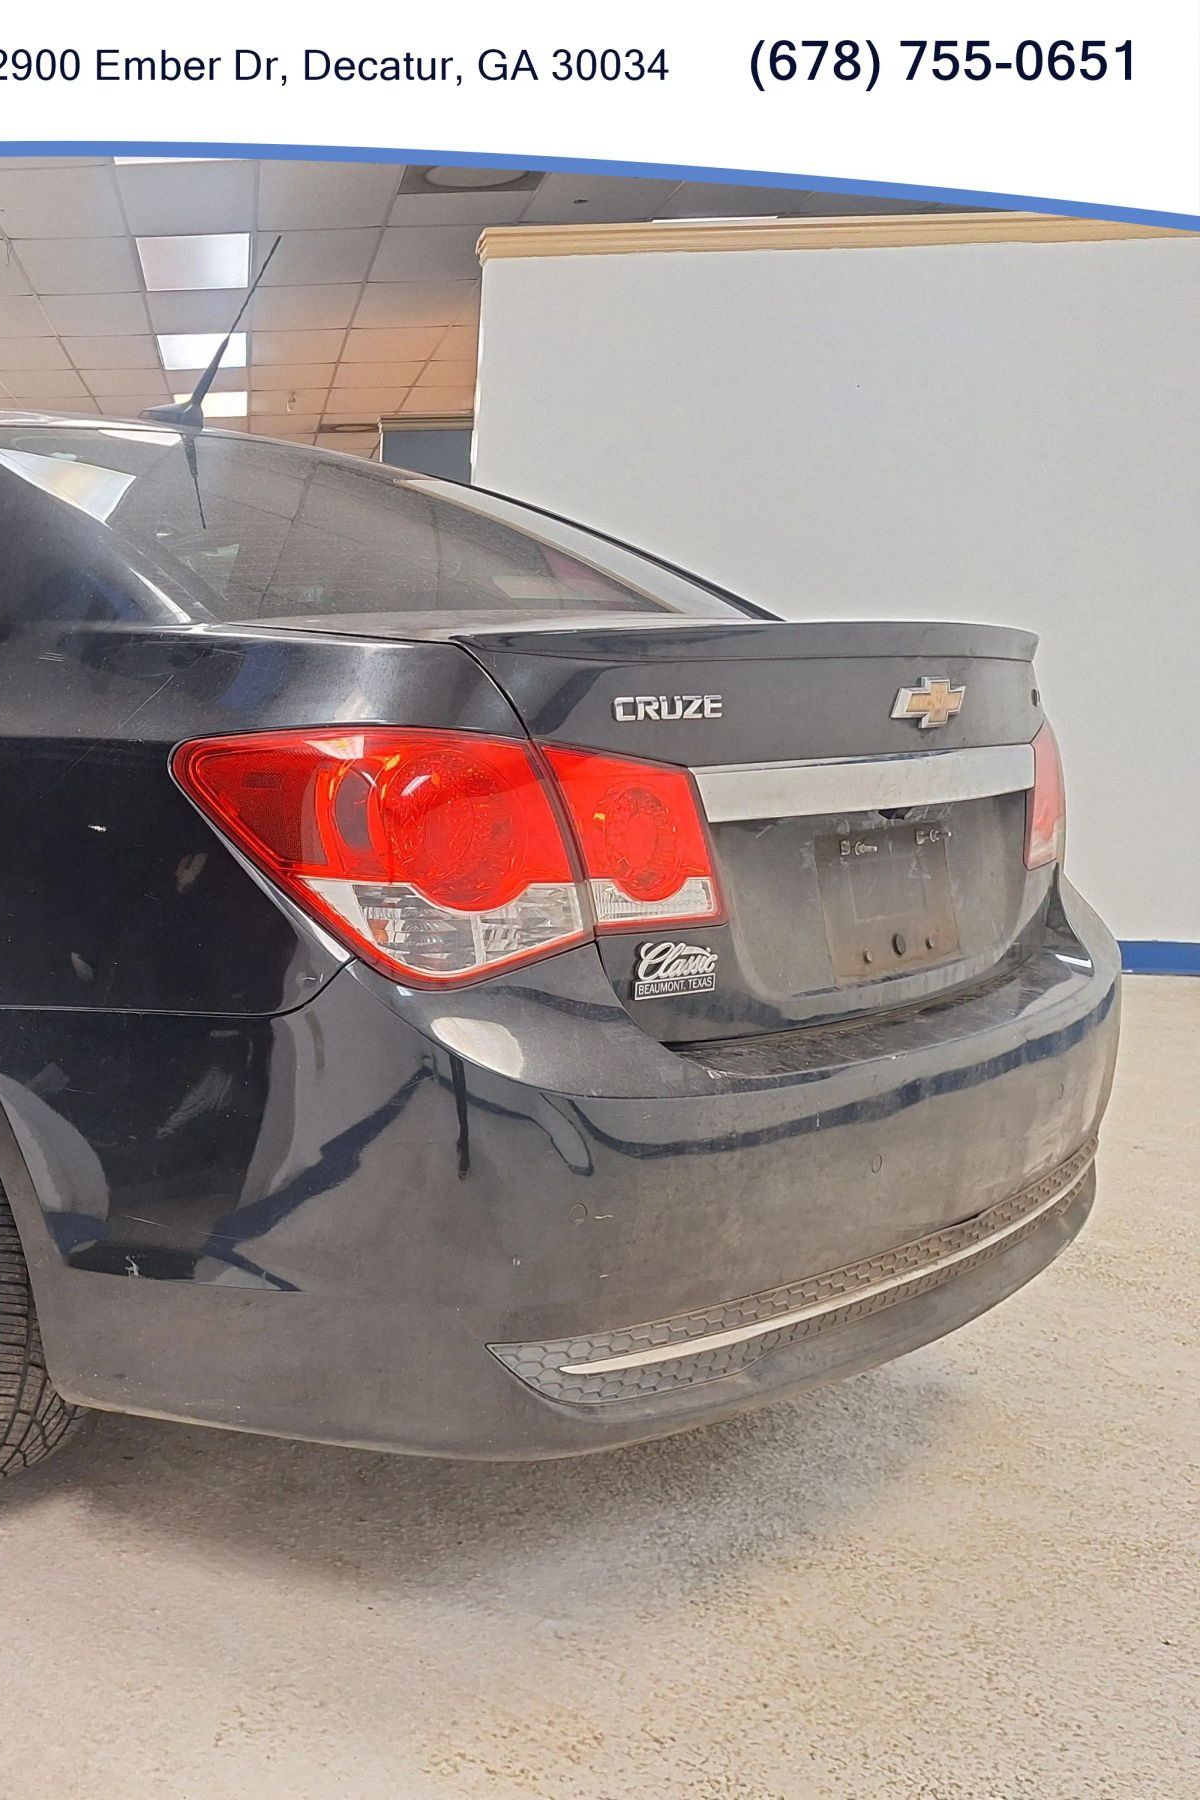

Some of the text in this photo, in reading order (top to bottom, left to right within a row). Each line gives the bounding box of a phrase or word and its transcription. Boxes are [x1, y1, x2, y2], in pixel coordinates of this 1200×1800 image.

[613, 694, 722, 721] CRUZE
[638, 942, 719, 980] Classic
[688, 976, 713, 989] TEXAS
